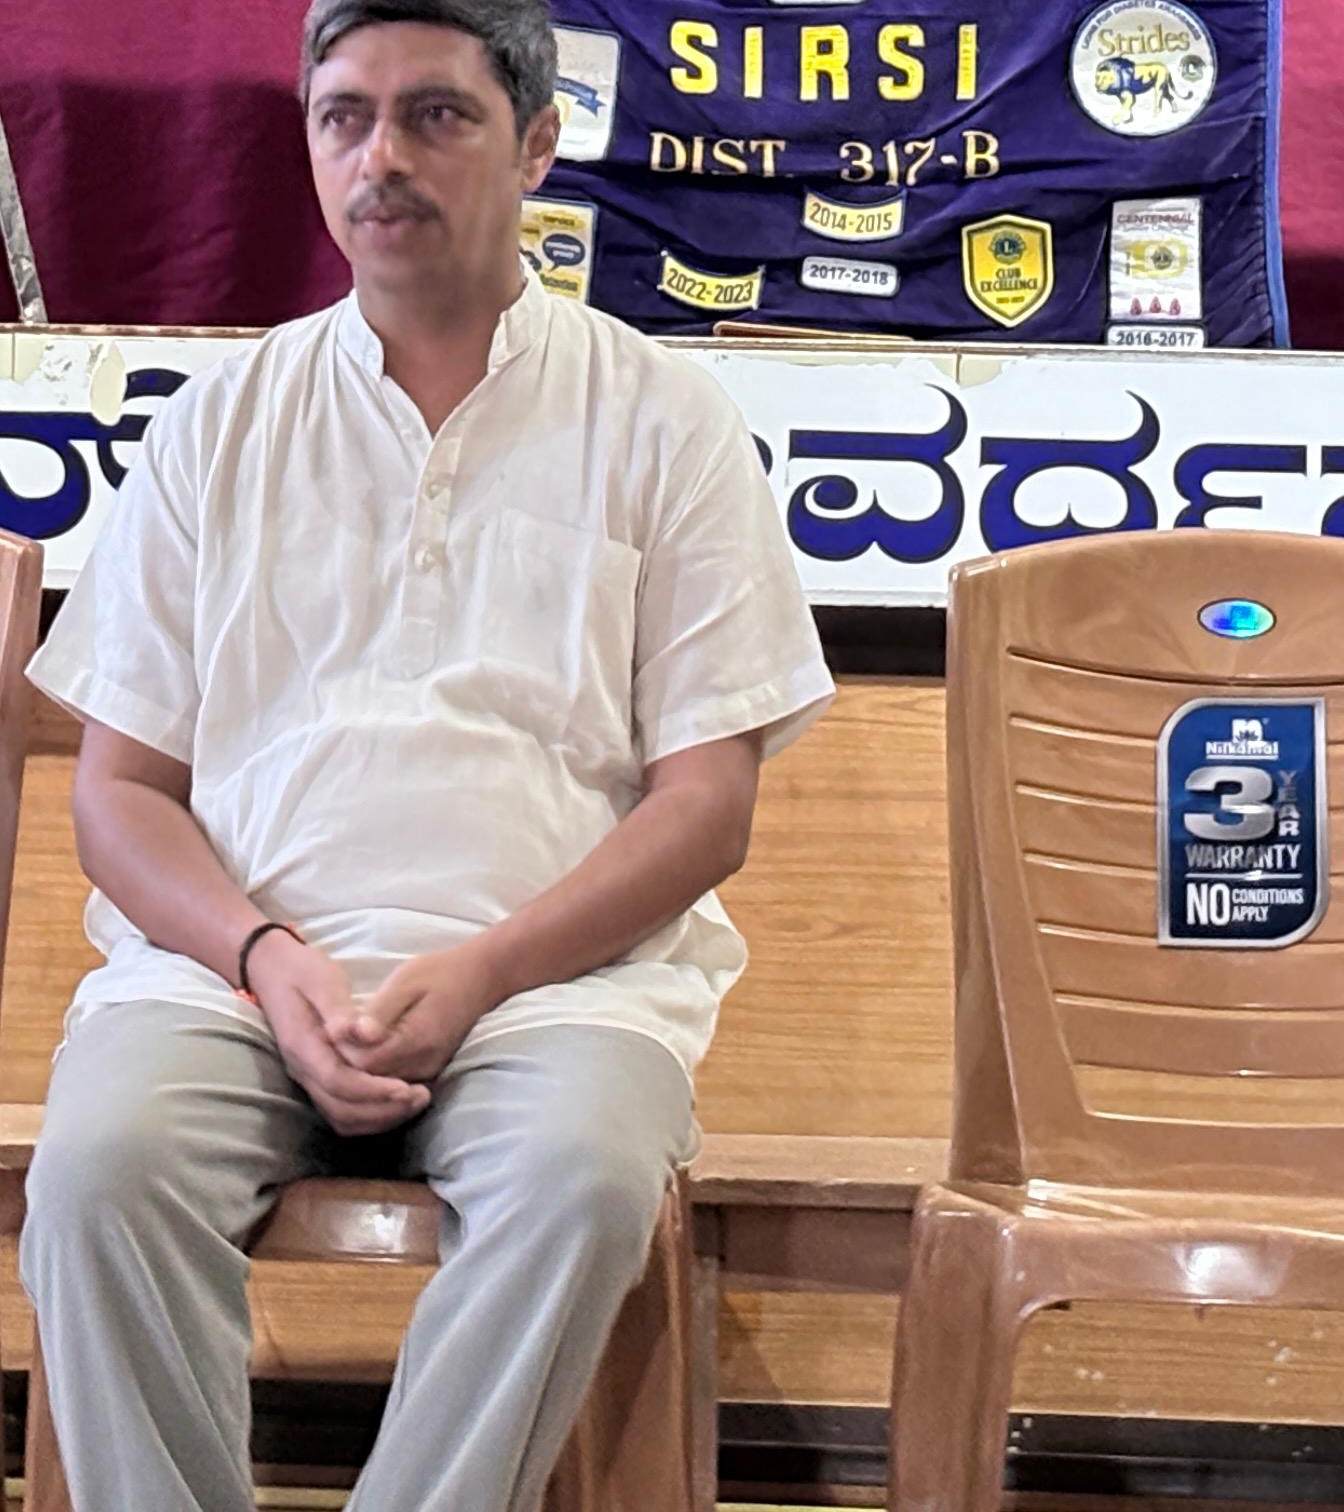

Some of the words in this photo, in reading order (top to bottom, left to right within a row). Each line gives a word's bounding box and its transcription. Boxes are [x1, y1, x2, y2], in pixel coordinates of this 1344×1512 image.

[1097, 23, 1191, 57] Strides
[669, 20, 978, 101] SIRSI
[838, 130, 1000, 187] 317-B
[809, 201, 894, 234] 2014-2015
[1116, 213, 1195, 224] CENTENNIAL
[665, 267, 755, 304] 2022-2023
[809, 265, 889, 285] 2017-2018
[1183, 765, 1277, 841] 3
[1184, 844, 1302, 869] WARRANTY
[1186, 882, 1231, 926] NO
[1232, 887, 1304, 906] CONDITIONS
[1232, 905, 1269, 923] APPLY
